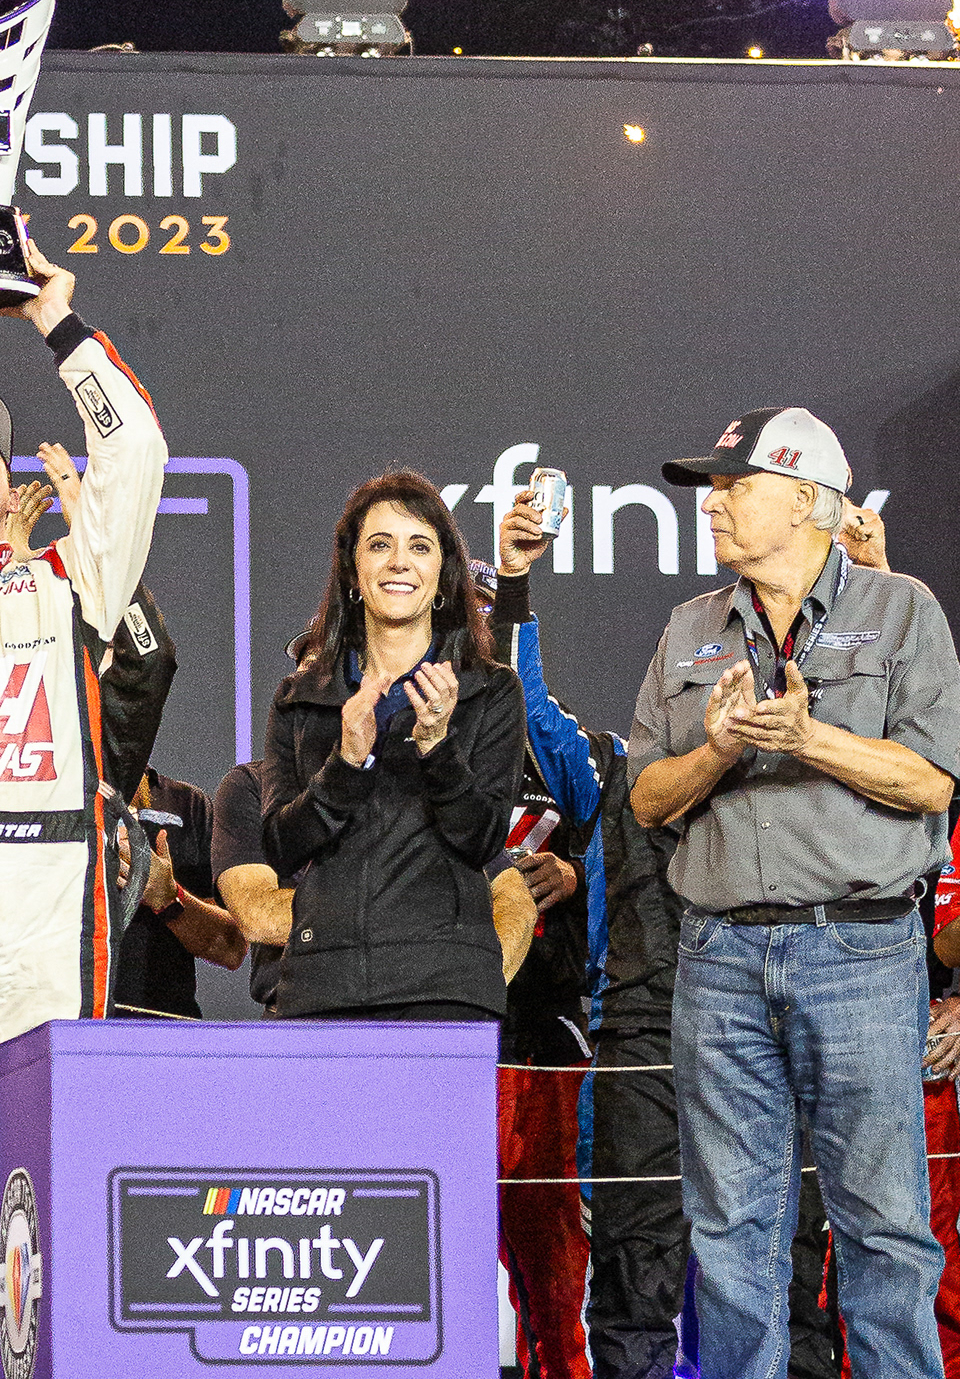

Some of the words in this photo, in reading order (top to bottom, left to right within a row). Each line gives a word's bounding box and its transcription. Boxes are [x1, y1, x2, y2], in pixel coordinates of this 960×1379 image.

[68, 214, 232, 257] 2023
[767, 445, 803, 470] 41
[804, 622, 824, 652] SERIES
[237, 1188, 346, 1215] NASCAR
[166, 1220, 385, 1298] xfinity
[232, 1286, 321, 1313] SERIES
[239, 1326, 394, 1356] CHAMPION
